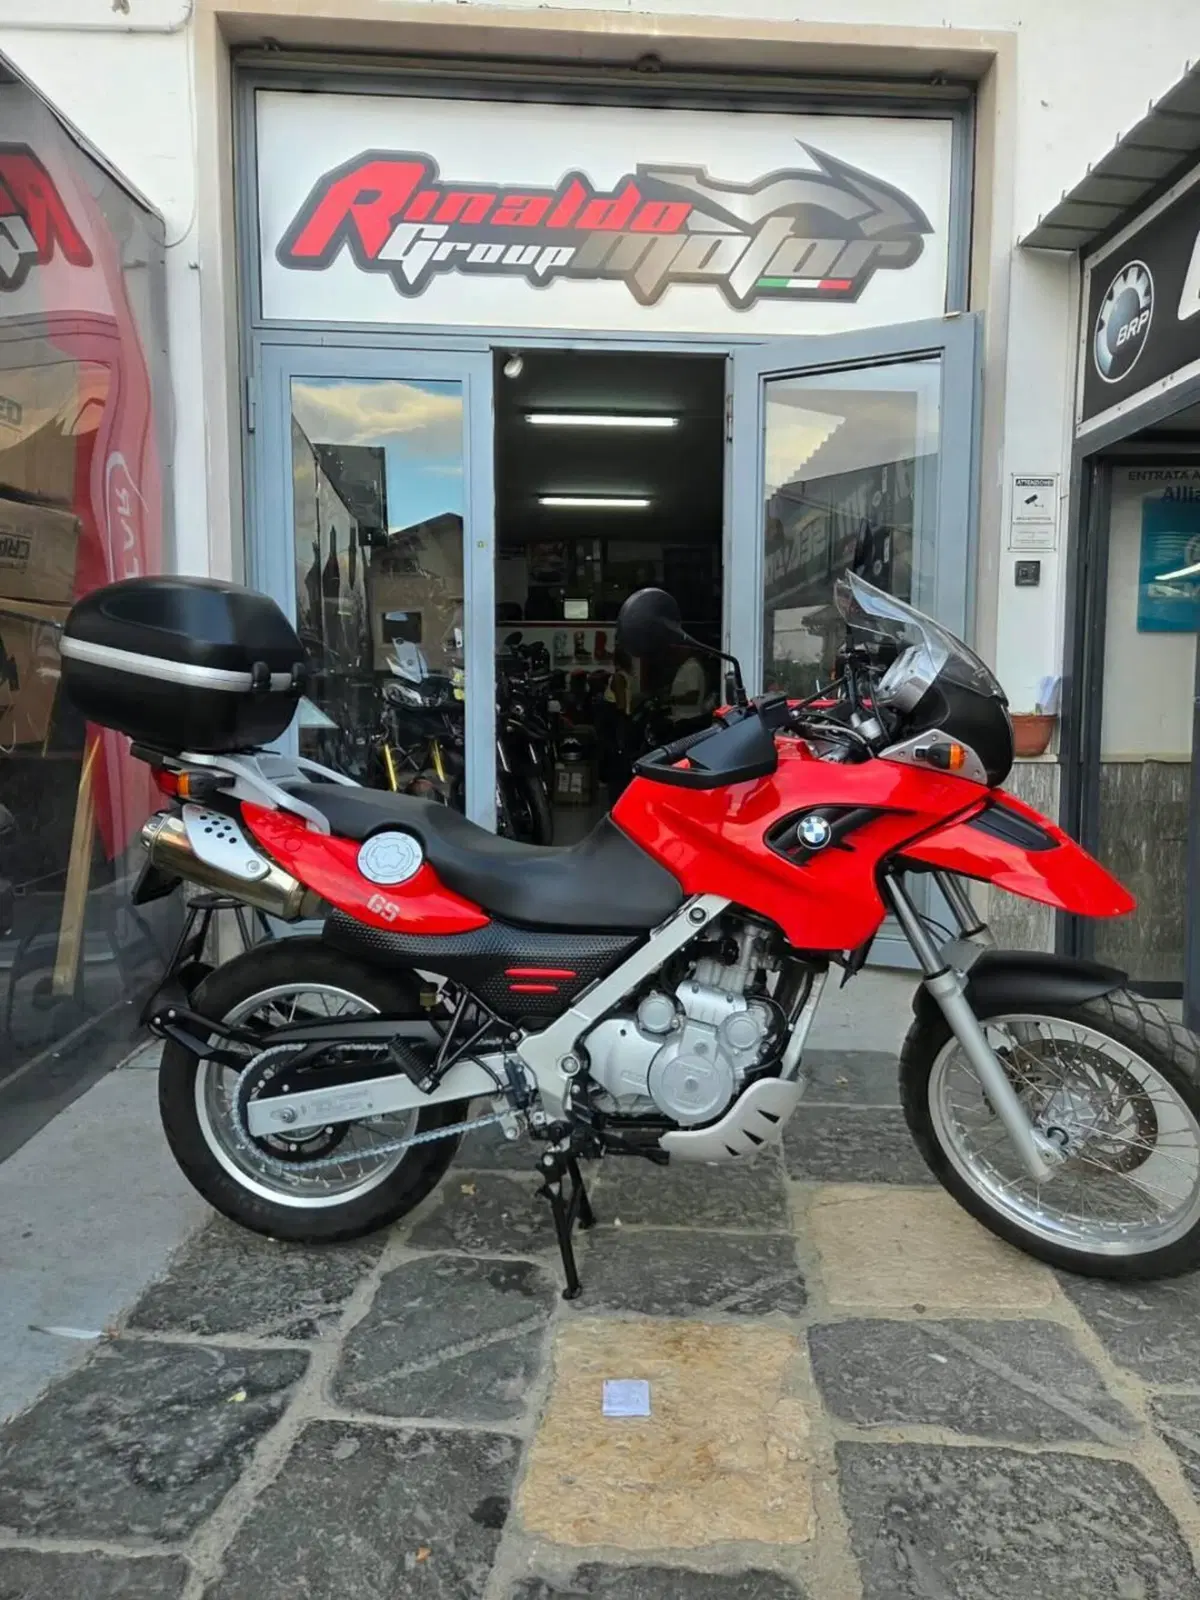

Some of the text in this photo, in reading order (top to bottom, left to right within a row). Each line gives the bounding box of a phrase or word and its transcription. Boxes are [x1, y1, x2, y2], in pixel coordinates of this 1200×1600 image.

[291, 160, 693, 259] Rinaldo
[377, 222, 576, 285] Group
[1116, 309, 1150, 347] BRP
[1128, 470, 1188, 481] ENTRATA
[366, 893, 401, 923] GS
